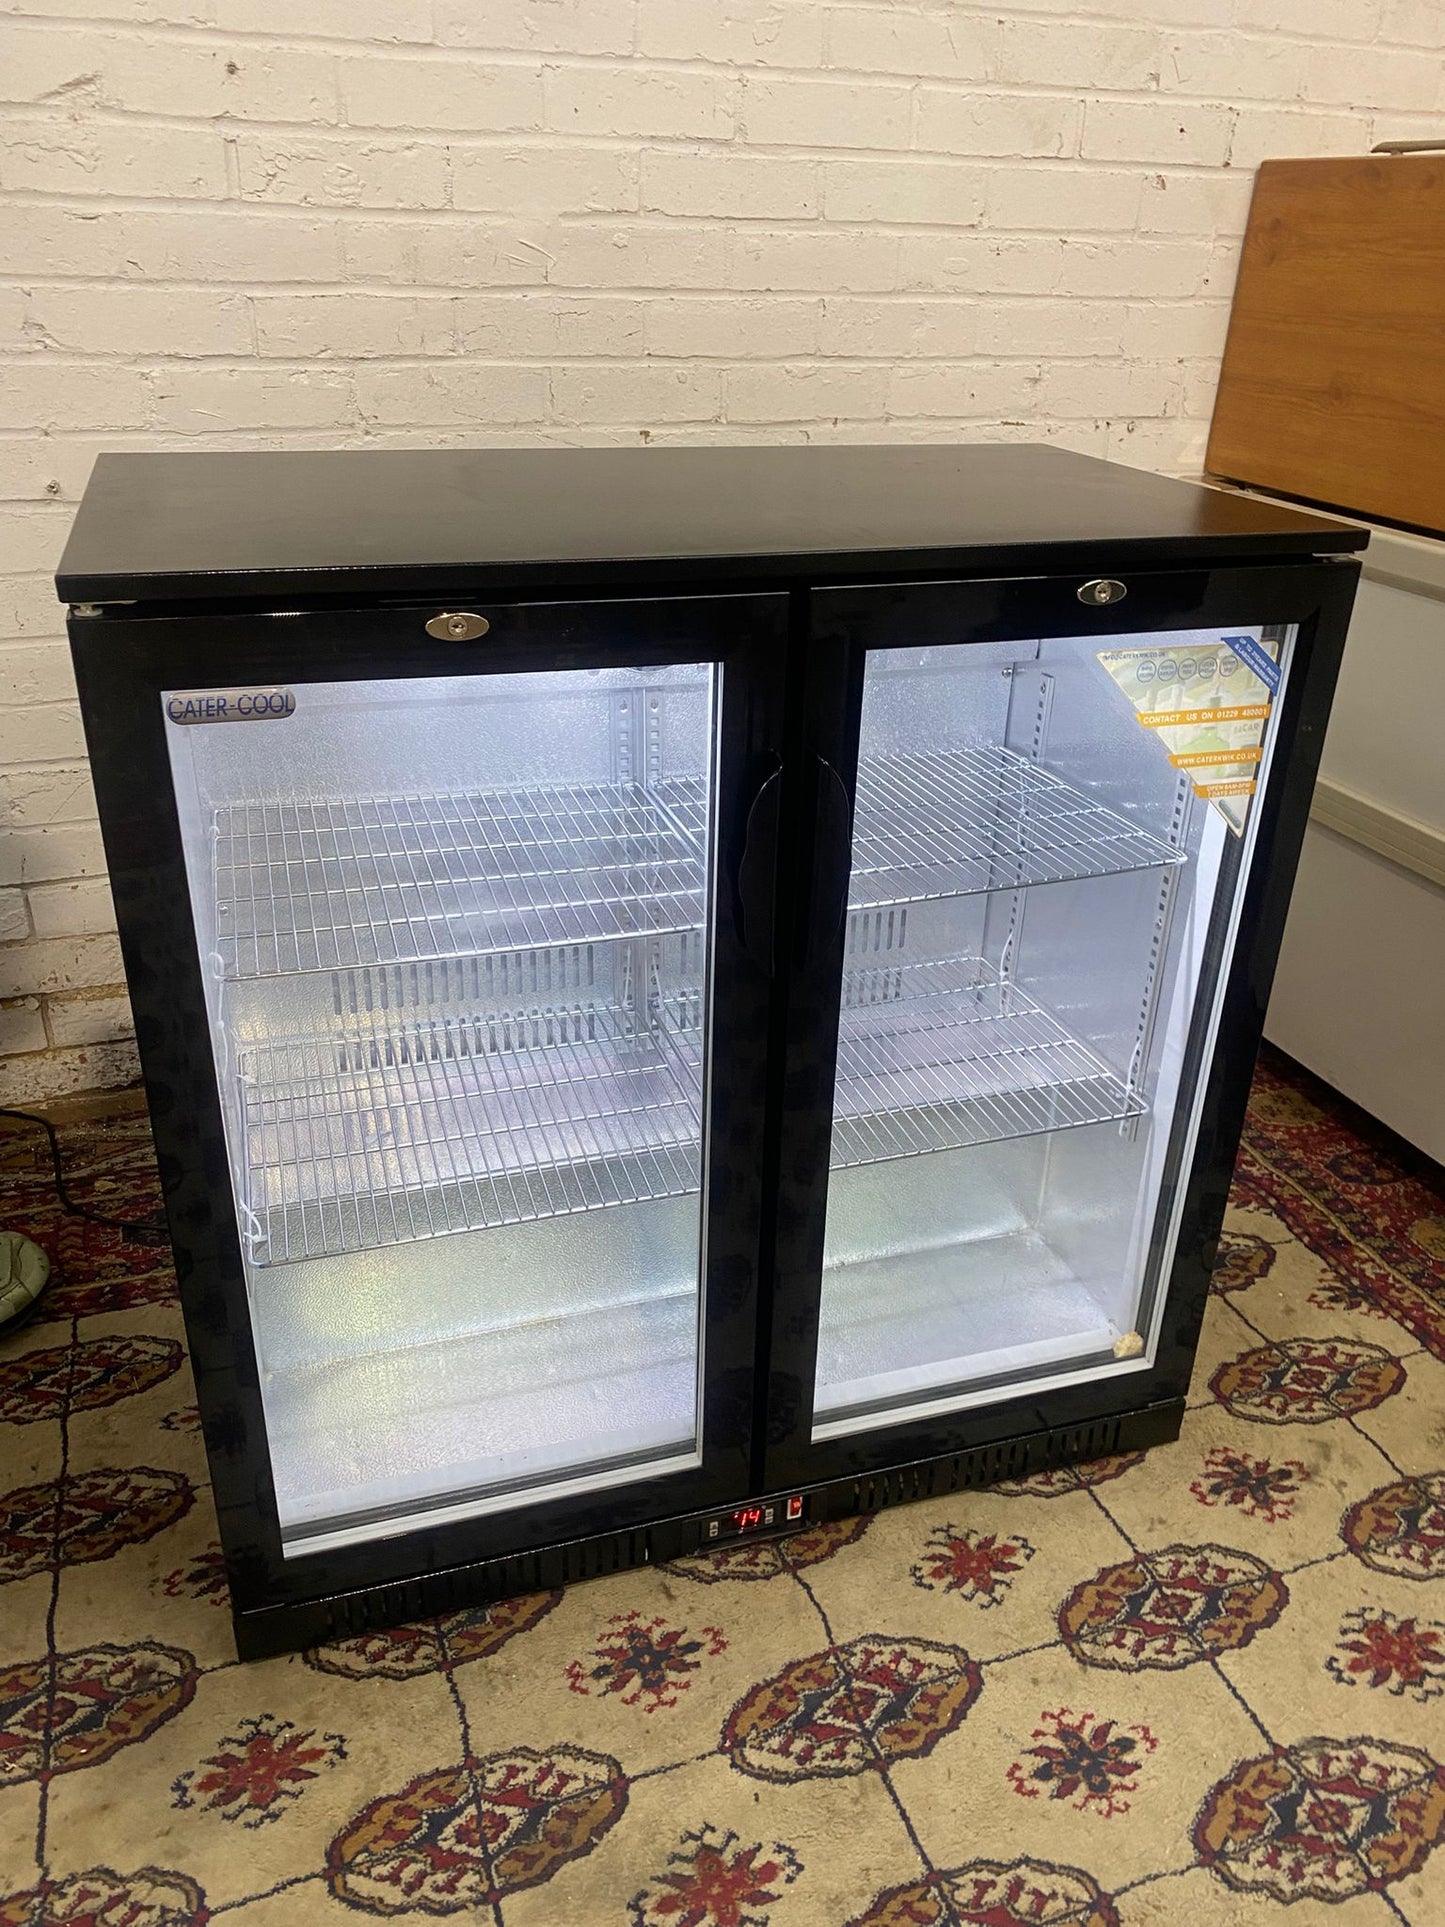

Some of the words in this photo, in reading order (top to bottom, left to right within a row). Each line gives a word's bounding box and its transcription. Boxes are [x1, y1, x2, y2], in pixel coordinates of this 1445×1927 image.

[167, 692, 295, 720] CATER-COOL
[1143, 714, 1180, 724] CONTACT
[1186, 712, 1198, 721] US
[1201, 710, 1213, 720] ON
[1216, 709, 1238, 719] 01229
[1177, 753, 1257, 766] WWW.CATERKWIK.CO.UK
